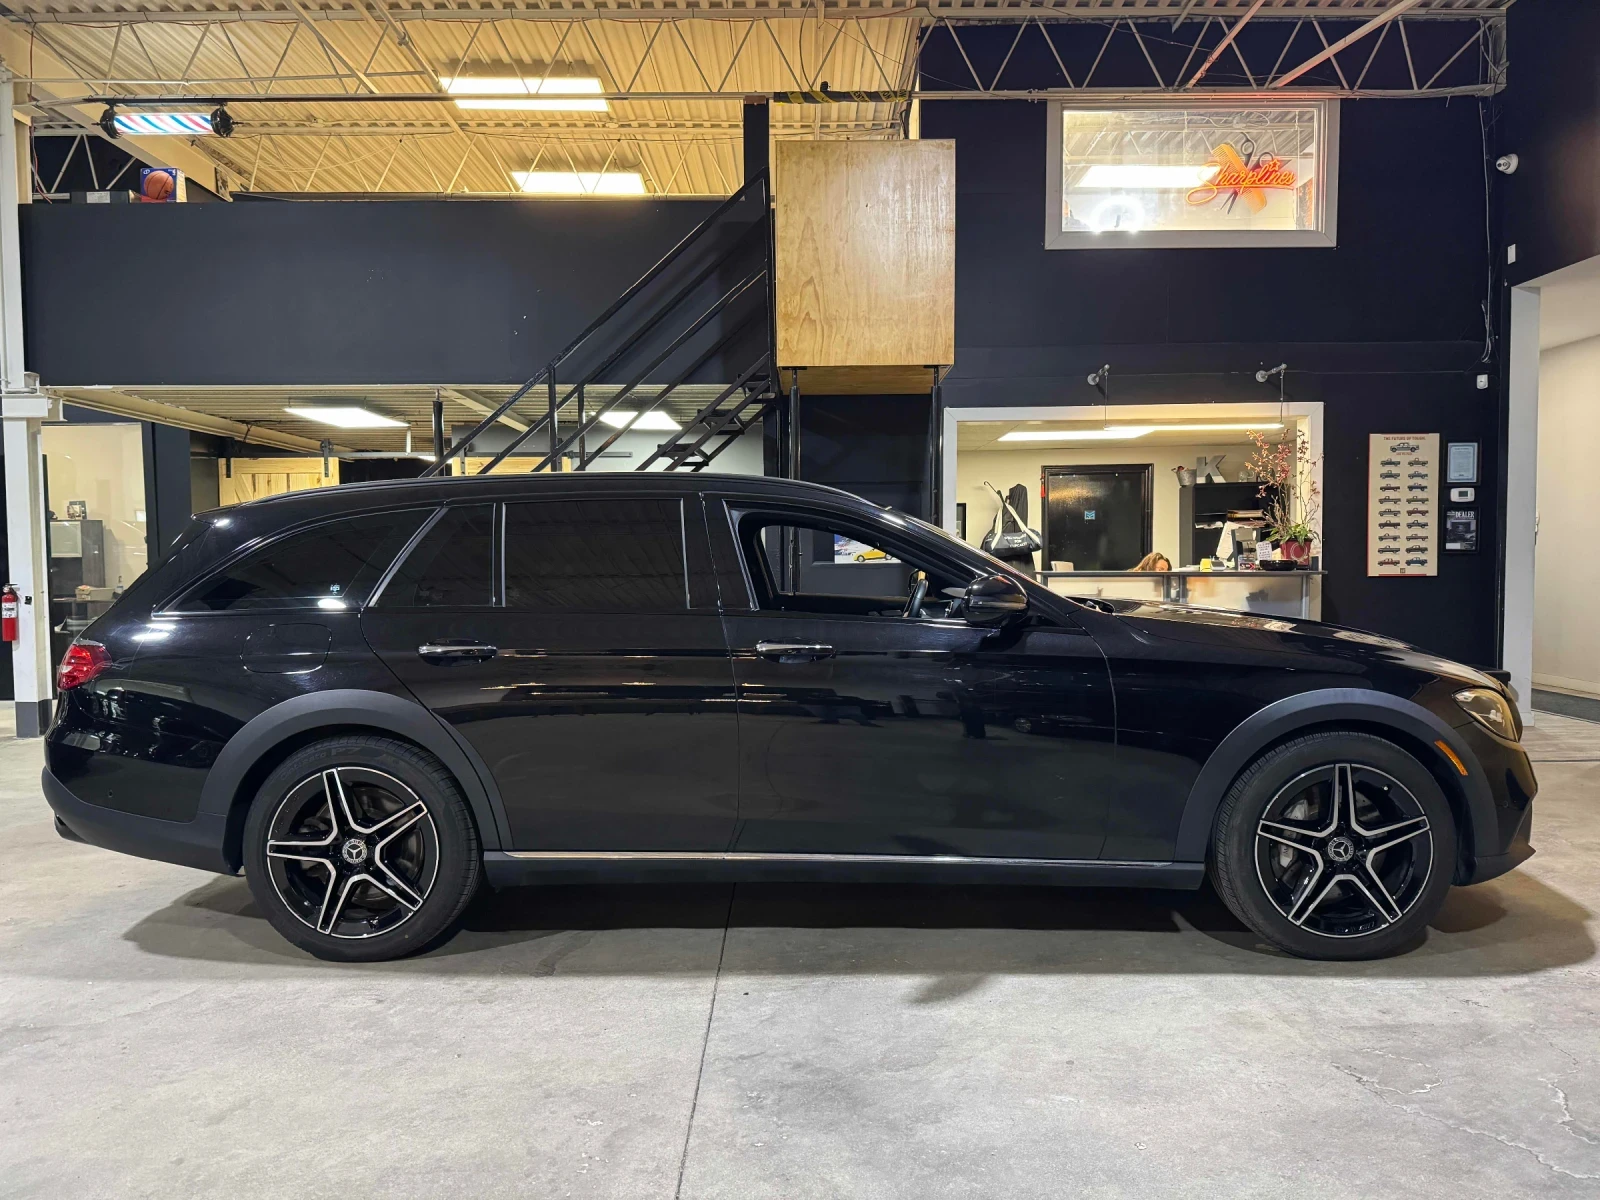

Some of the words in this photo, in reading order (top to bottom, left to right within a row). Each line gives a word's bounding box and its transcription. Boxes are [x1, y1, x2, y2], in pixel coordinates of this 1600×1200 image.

[1186, 160, 1297, 205] Sharplines
[1196, 455, 1226, 483] K
[1455, 511, 1475, 519] DEALER
